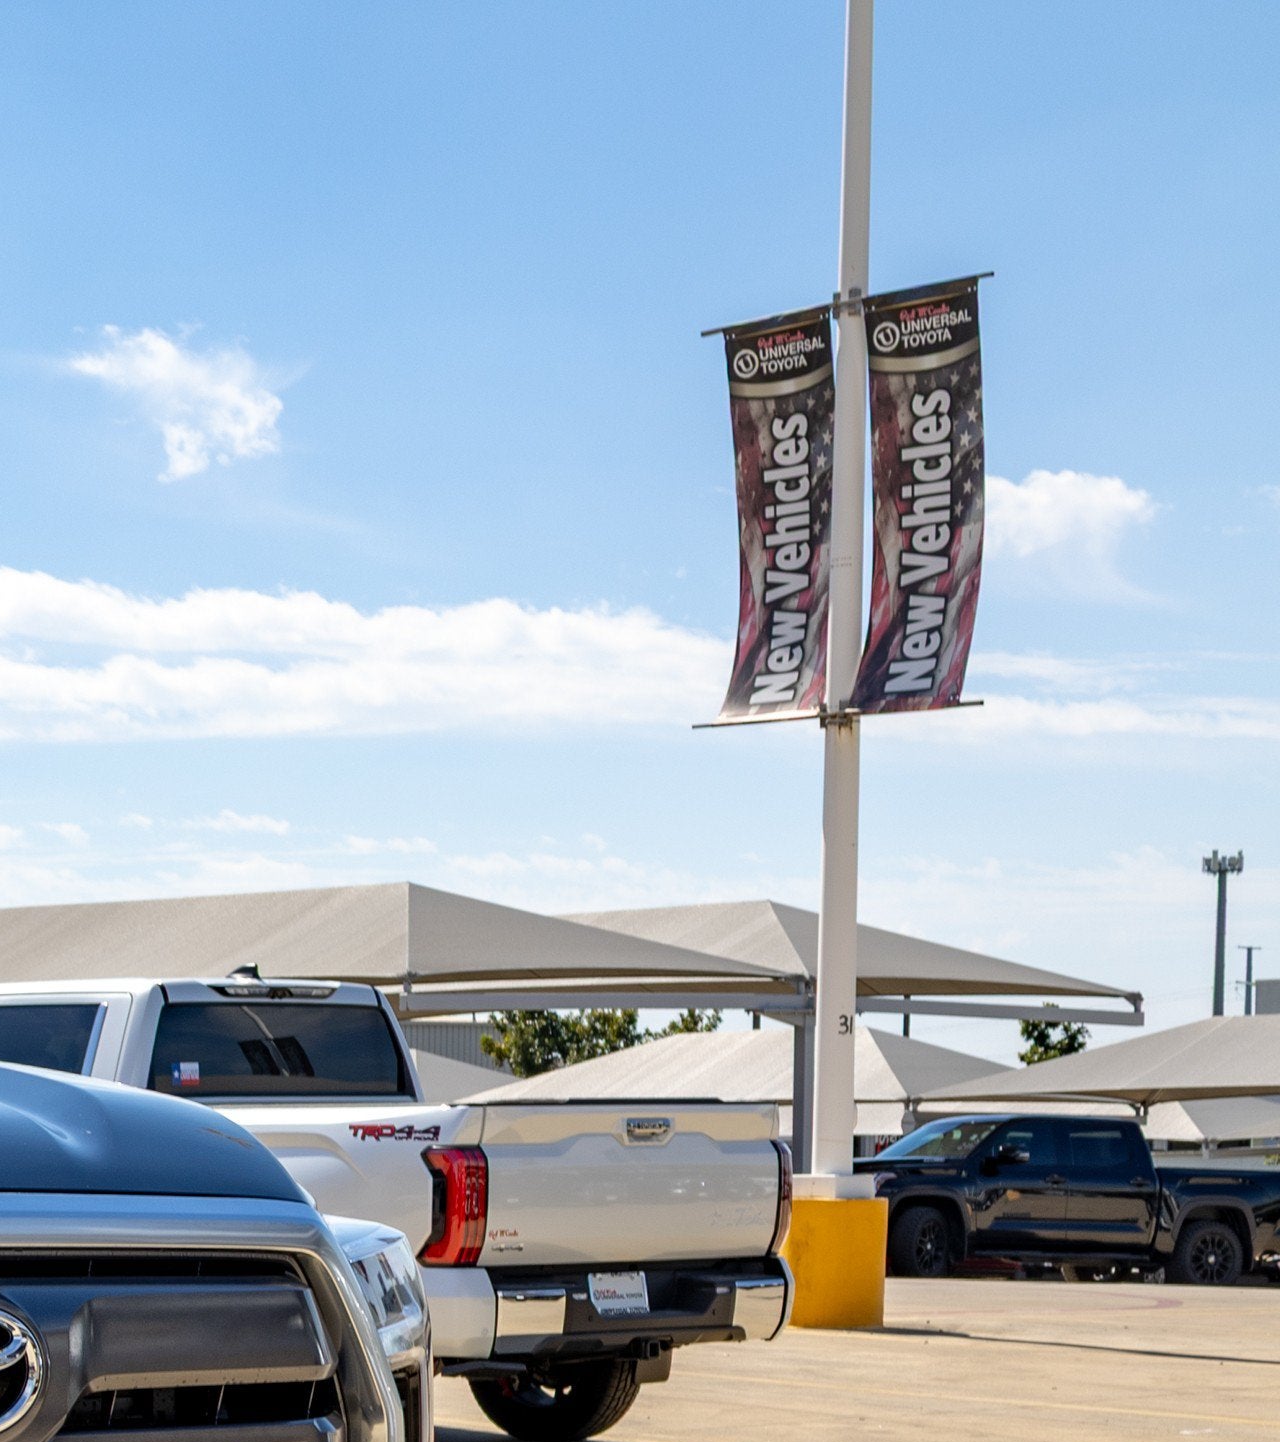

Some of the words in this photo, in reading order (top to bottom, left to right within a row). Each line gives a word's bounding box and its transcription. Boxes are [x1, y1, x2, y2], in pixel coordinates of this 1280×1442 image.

[901, 308, 972, 334] UNIVERSAL
[759, 336, 825, 361] UNIVERSAL
[901, 327, 952, 349] TOYOTA
[760, 354, 808, 375] TOYOTA
[900, 388, 951, 586] Vehicles
[763, 411, 811, 604] Vehicles
[884, 594, 945, 693] New
[749, 609, 808, 706] New
[838, 1014, 853, 1035] 31
[348, 1123, 396, 1141] TRD
